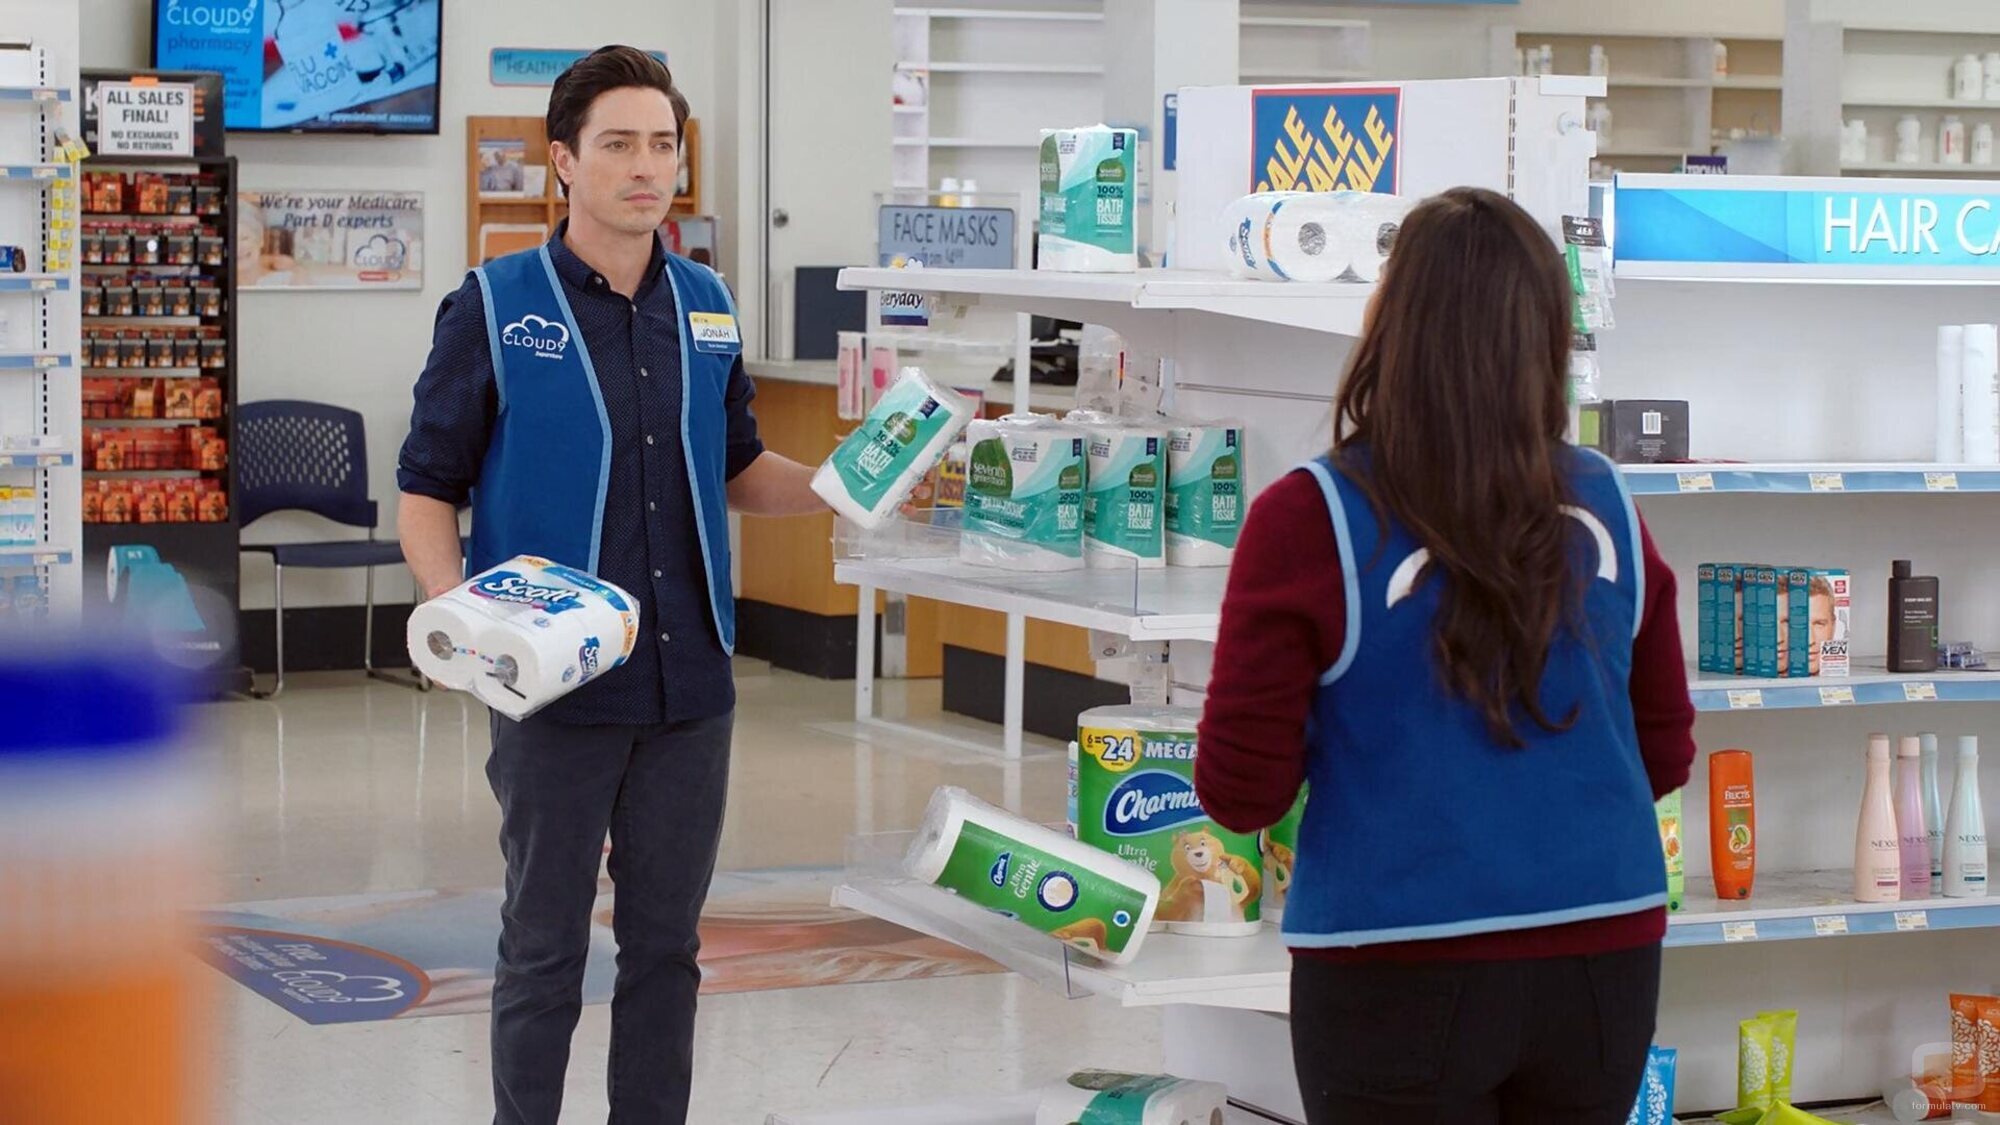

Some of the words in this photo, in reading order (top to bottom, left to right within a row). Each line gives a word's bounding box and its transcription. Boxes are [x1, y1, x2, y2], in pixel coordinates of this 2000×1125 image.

[166, 6, 255, 26] CLOUD9
[167, 31, 253, 54] pharmacy
[506, 60, 557, 75] HEALTH
[107, 90, 133, 105] ALL
[138, 91, 184, 106] SALES
[122, 109, 169, 123] FINAL!
[111, 130, 123, 139] NO
[126, 131, 179, 140] EXCHANGES
[117, 141, 130, 150] NO
[132, 142, 174, 151] RETURNS
[1097, 185, 1124, 194] 100%
[259, 195, 304, 210] We're
[307, 196, 345, 210] your
[348, 195, 418, 211] Medicare
[1096, 199, 1124, 213] BATH
[284, 213, 317, 228] Part
[323, 214, 333, 228] D
[337, 214, 394, 229] experts
[1096, 213, 1123, 225] TISSUE
[1824, 196, 1939, 254] HAIR
[1956, 199, 2000, 255] C
[894, 213, 934, 243] FACE
[939, 214, 999, 246] MASKS
[701, 327, 730, 339] JONAH
[502, 332, 566, 352] CLOUD9
[973, 462, 1006, 479] seventh
[1213, 482, 1237, 490] 100%
[1130, 490, 1155, 499] 100%
[1213, 495, 1237, 508] BATH
[1128, 503, 1154, 517] BATH
[1213, 508, 1236, 521] TISSUE
[1128, 517, 1152, 530] TISSUE
[484, 576, 580, 603] Scott
[1821, 646, 1848, 656] MEN
[1101, 735, 1134, 761] 24
[1145, 741, 1199, 760] MEGA
[1118, 844, 1148, 857] Ultra
[1010, 862, 1027, 887] Ultra
[1014, 858, 1041, 899] Gentle
